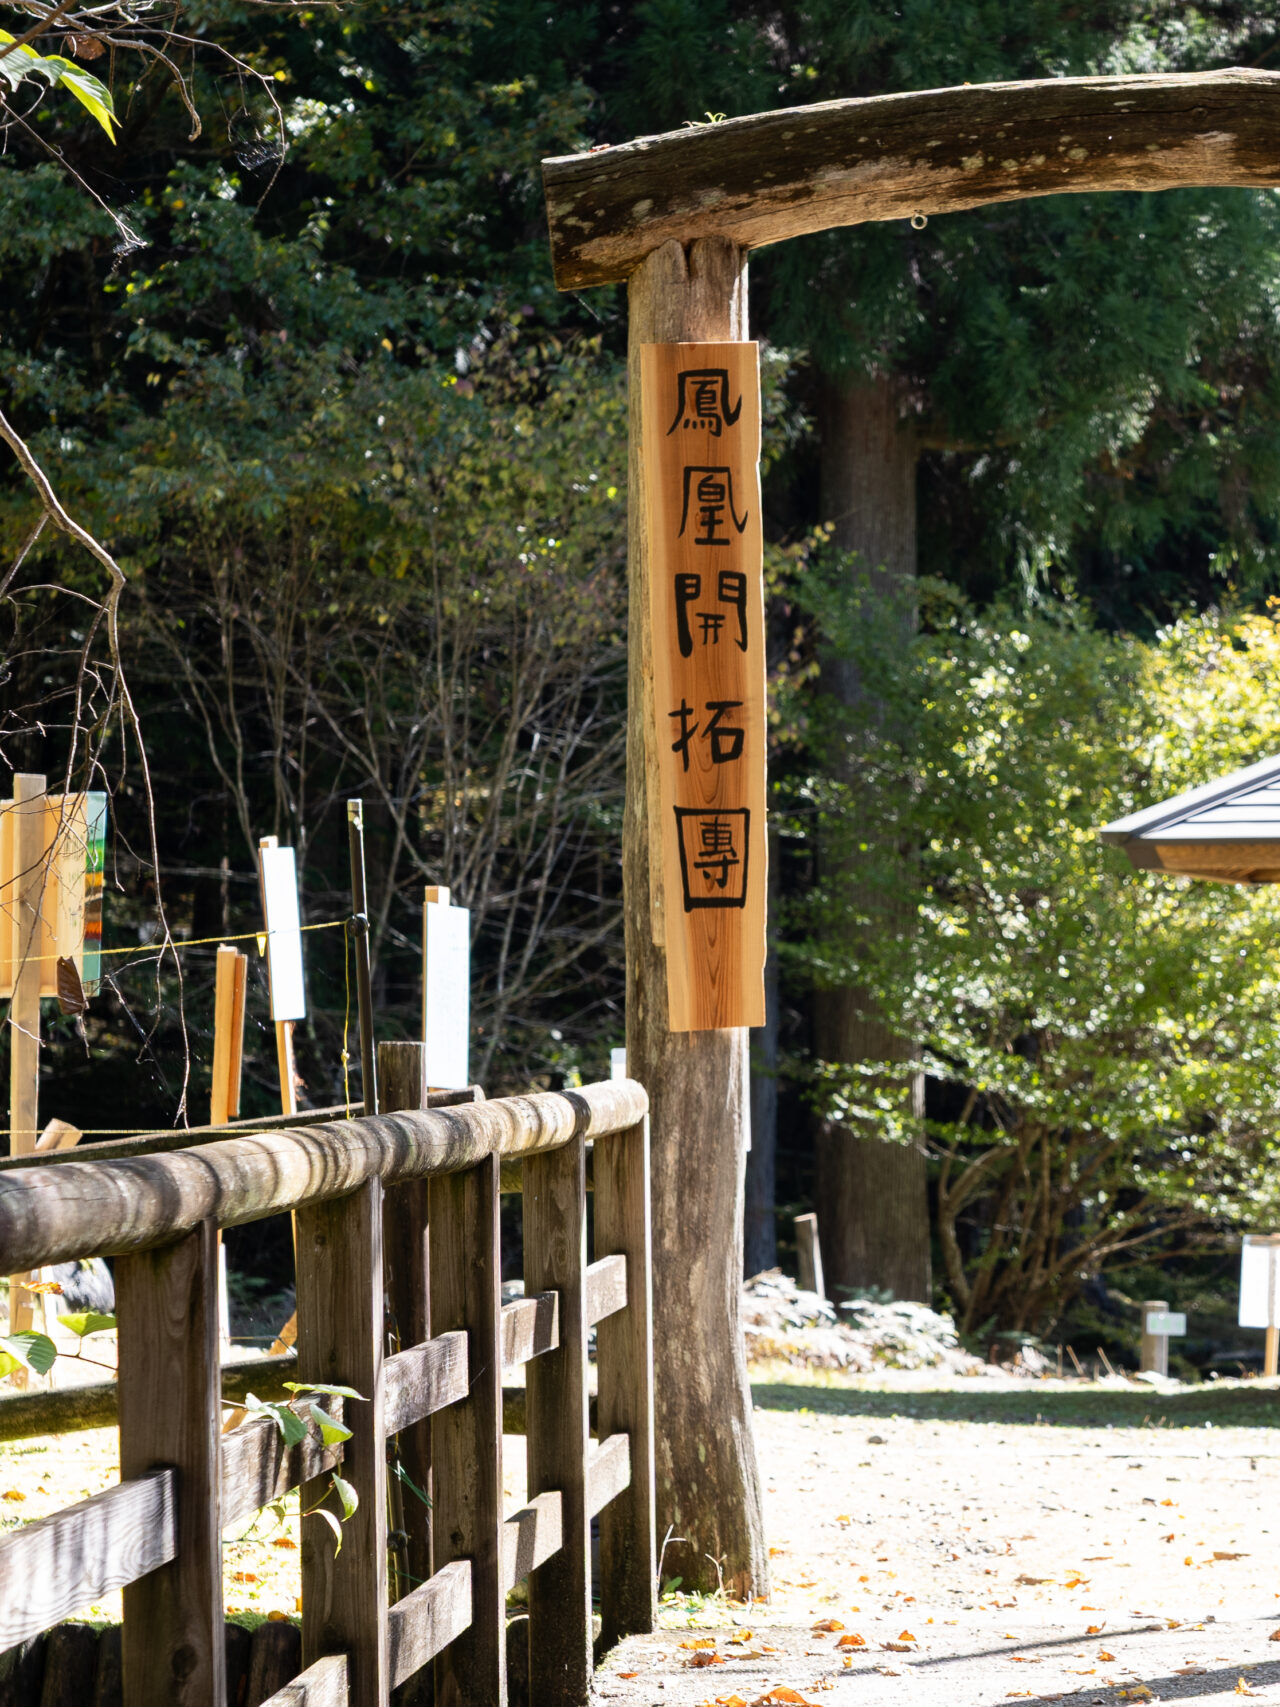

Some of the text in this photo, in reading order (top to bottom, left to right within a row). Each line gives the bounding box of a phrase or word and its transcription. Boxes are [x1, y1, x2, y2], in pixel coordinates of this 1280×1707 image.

[666, 367, 751, 913] 鳳凰開拓團
